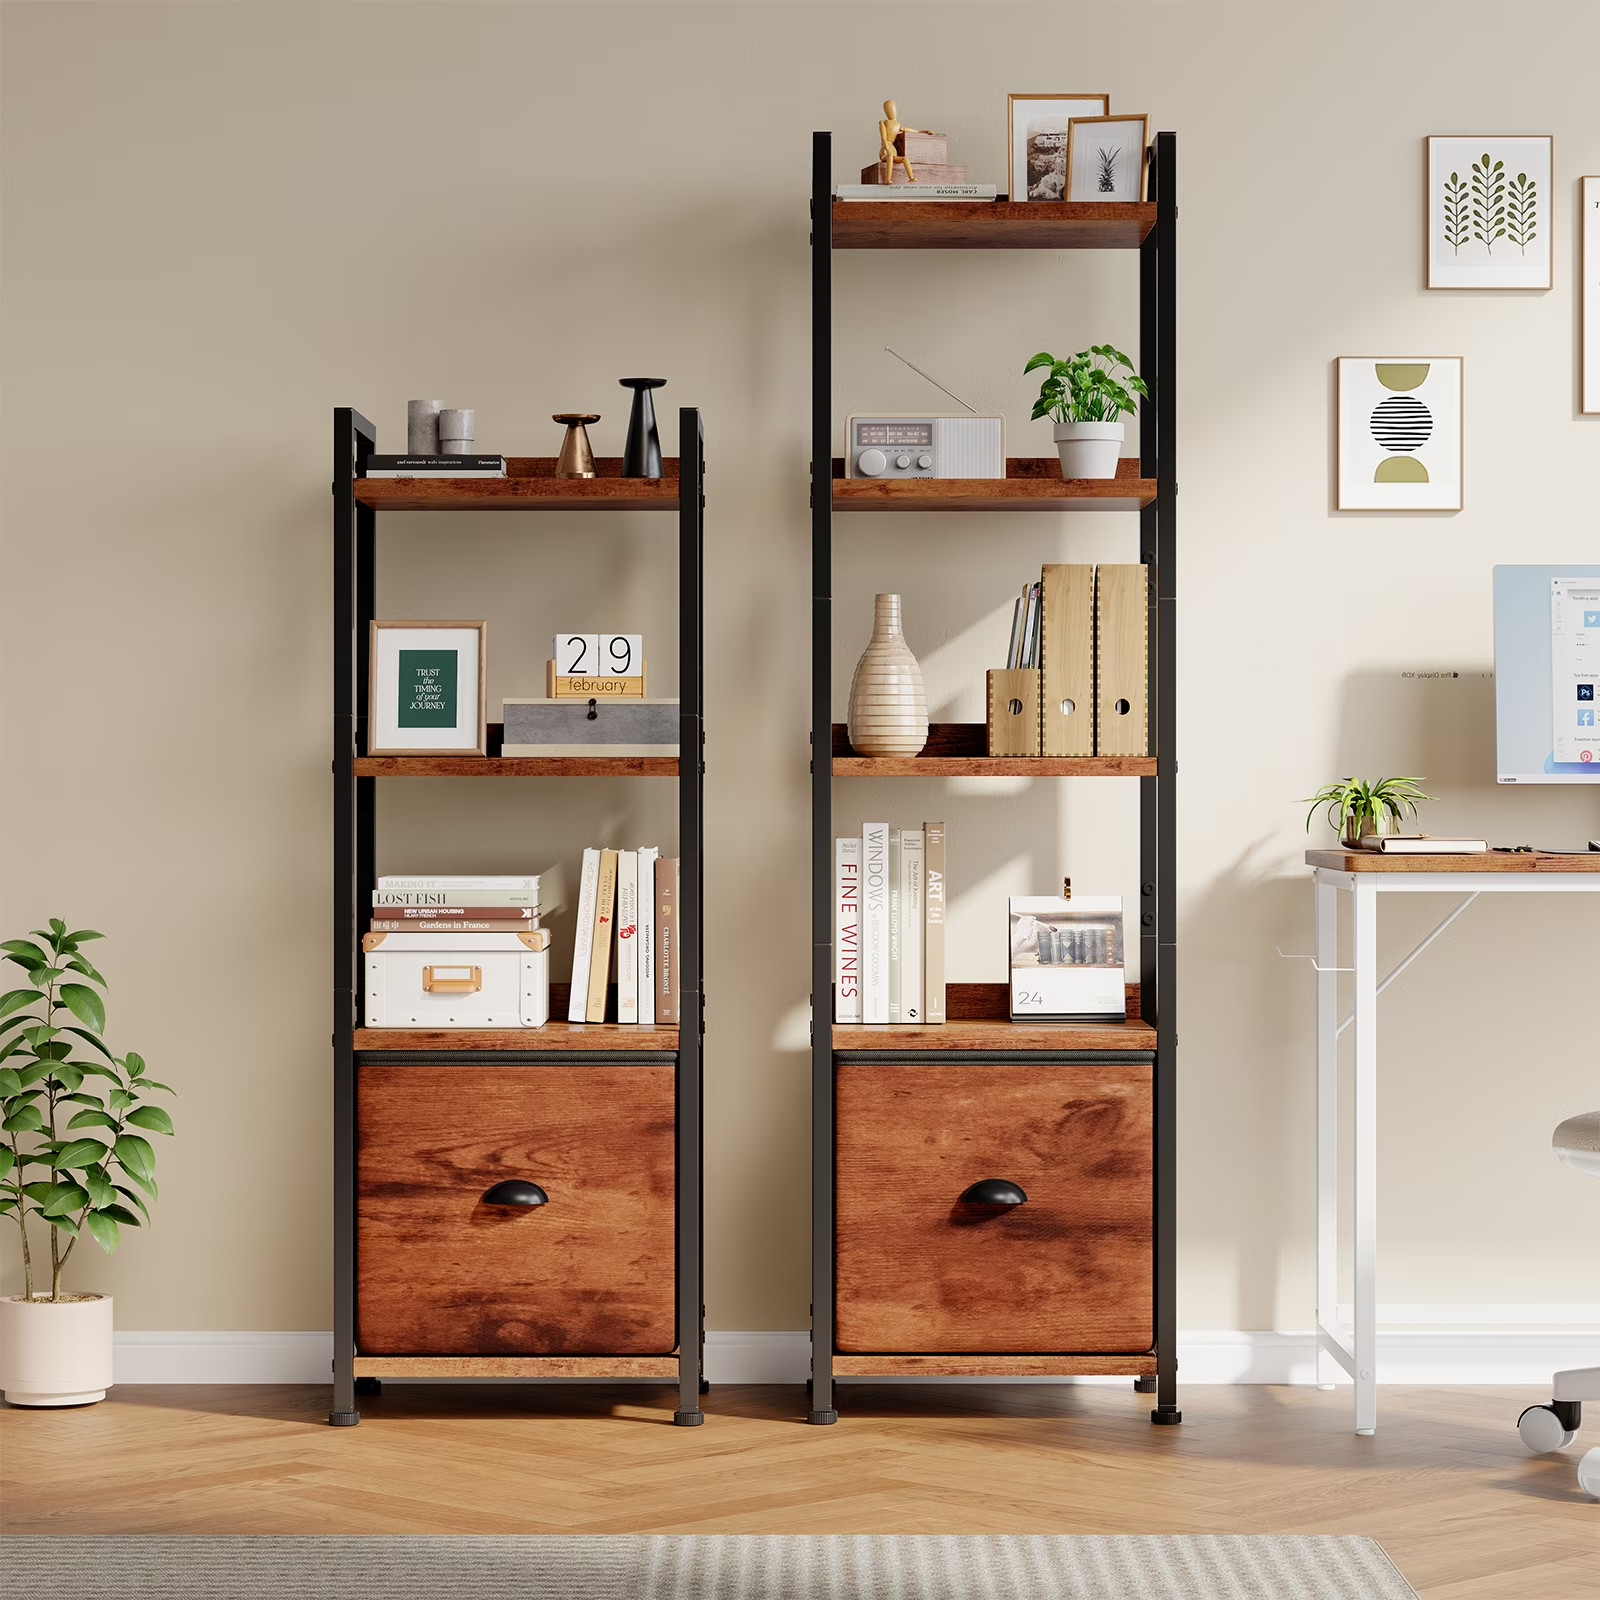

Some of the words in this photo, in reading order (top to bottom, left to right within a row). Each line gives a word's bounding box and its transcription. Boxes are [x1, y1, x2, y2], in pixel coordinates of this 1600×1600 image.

[416, 668, 441, 676] TRUST
[414, 685, 442, 693] TIMING
[568, 677, 627, 695] february
[423, 694, 441, 702] your
[409, 701, 446, 710] JOURNEY
[868, 828, 884, 912] WINDOWS
[385, 880, 424, 888] MAKING
[426, 880, 437, 888] IT
[841, 864, 858, 913] FINE
[928, 869, 943, 902] ART
[377, 893, 413, 904] LOST
[416, 893, 446, 904] FISH
[419, 921, 452, 929] Gardens
[453, 921, 461, 929] in
[463, 921, 490, 929] France
[841, 924, 858, 998] WINES
[1018, 991, 1043, 1005] 24
